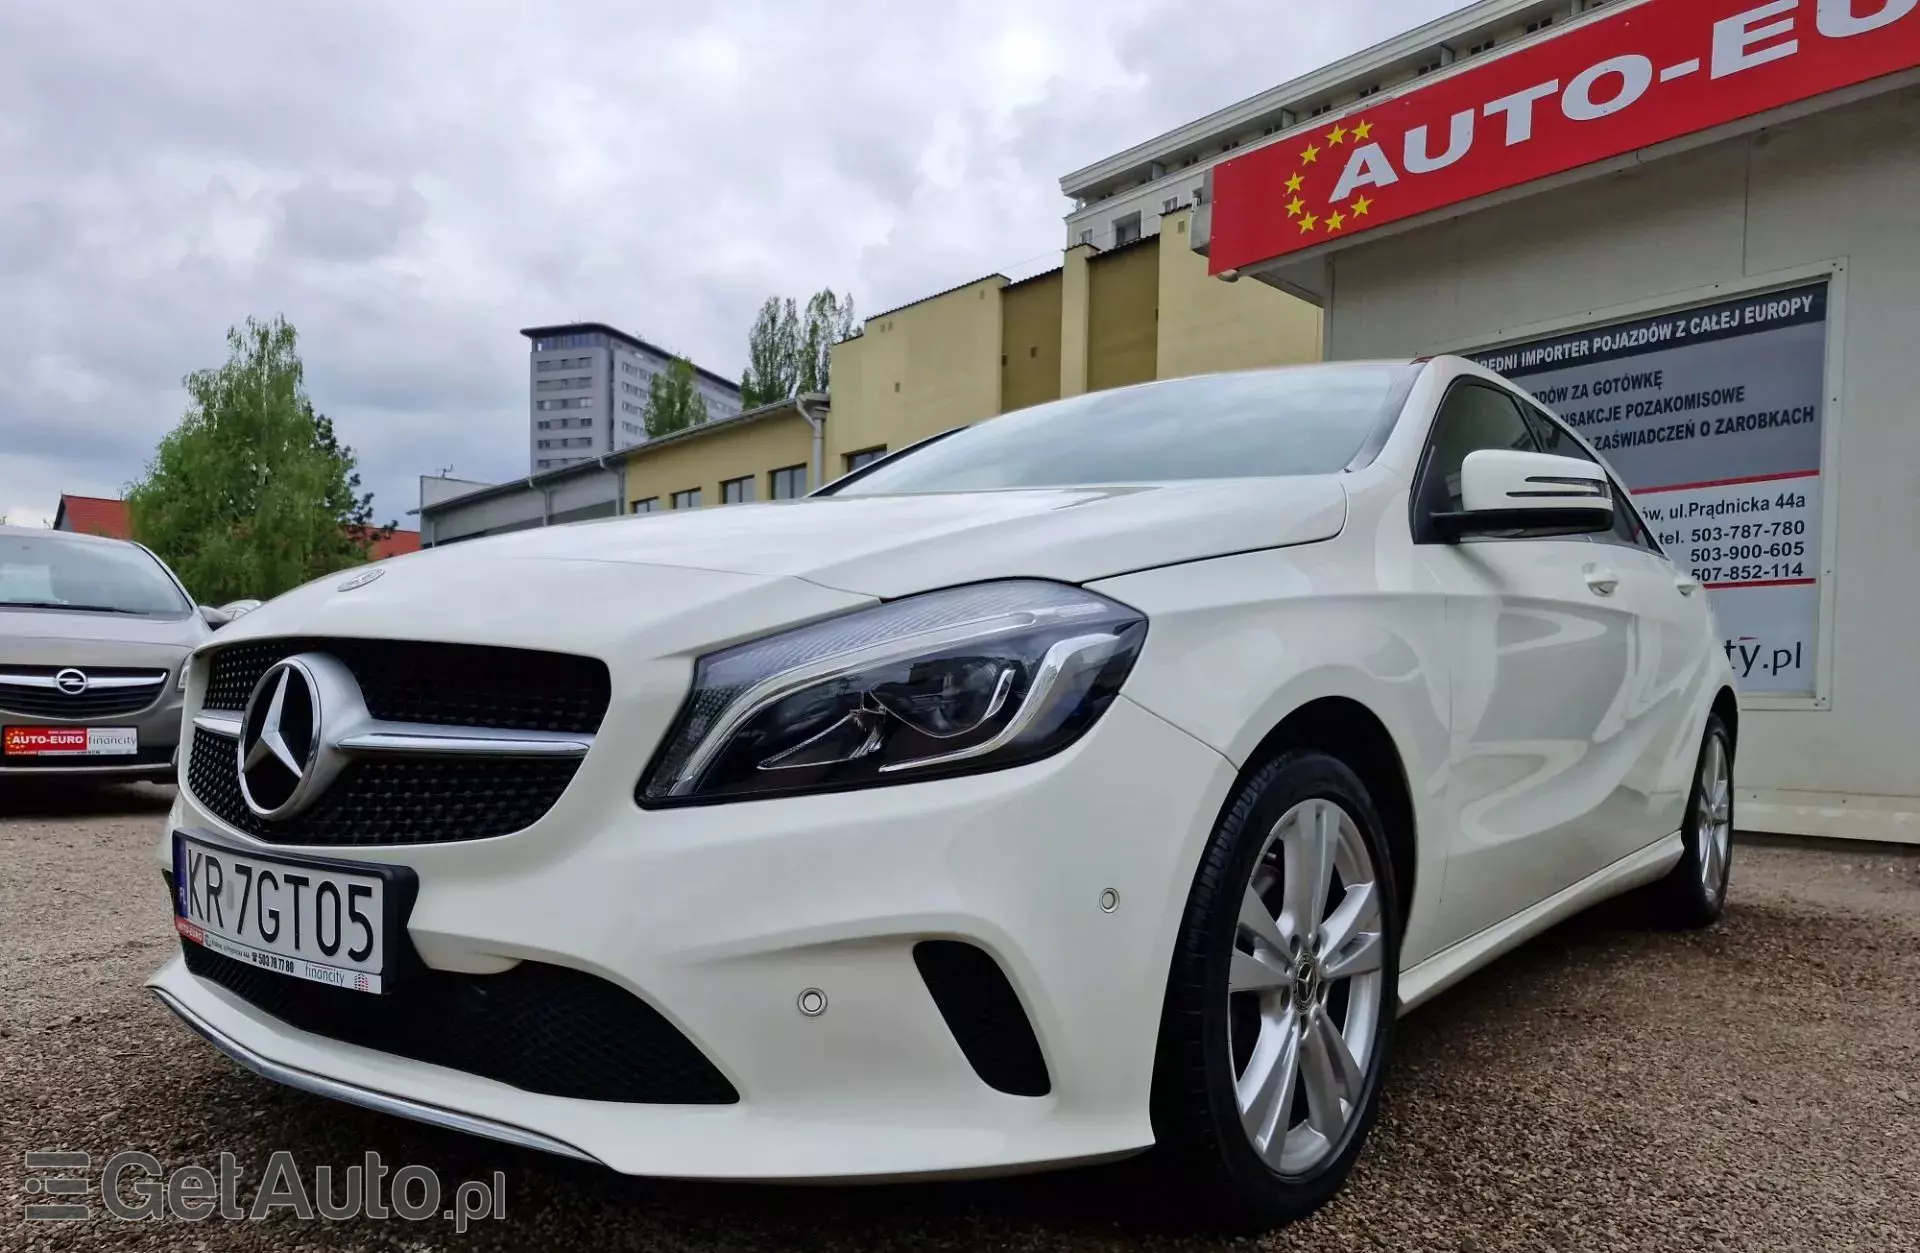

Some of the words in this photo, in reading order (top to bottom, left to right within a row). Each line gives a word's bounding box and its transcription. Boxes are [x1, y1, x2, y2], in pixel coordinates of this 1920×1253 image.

[1474, 353, 1517, 372] REDNI
[1521, 340, 1589, 367] IMPORTER
[1593, 322, 1673, 353] POJAZDÓW
[1676, 320, 1686, 338] Z
[1690, 309, 1740, 334] CAŁEJ
[1744, 294, 1814, 325] EUROPY
[1571, 383, 1589, 400] ZA
[1593, 370, 1663, 397] GOTÓWKĘ
[1625, 385, 1746, 419] POZAKOMISOWE
[1594, 419, 1695, 451] ZAŚWIADCZEŃ
[1700, 420, 1711, 437] O
[1715, 406, 1815, 436] ZAROBKACH
[1775, 492, 1806, 509] 44a
[1658, 530, 1685, 545] tel.
[1690, 520, 1805, 543] 503-787-780
[1690, 541, 1805, 563] 503-900-605
[1691, 562, 1804, 582] 507-852-114
[11, 735, 84, 744] AUTO-EURO
[88, 734, 136, 745] financity
[187, 848, 225, 929] KR
[235, 863, 374, 962] 7GT05
[258, 953, 270, 967] 503
[285, 960, 294, 973] 80
